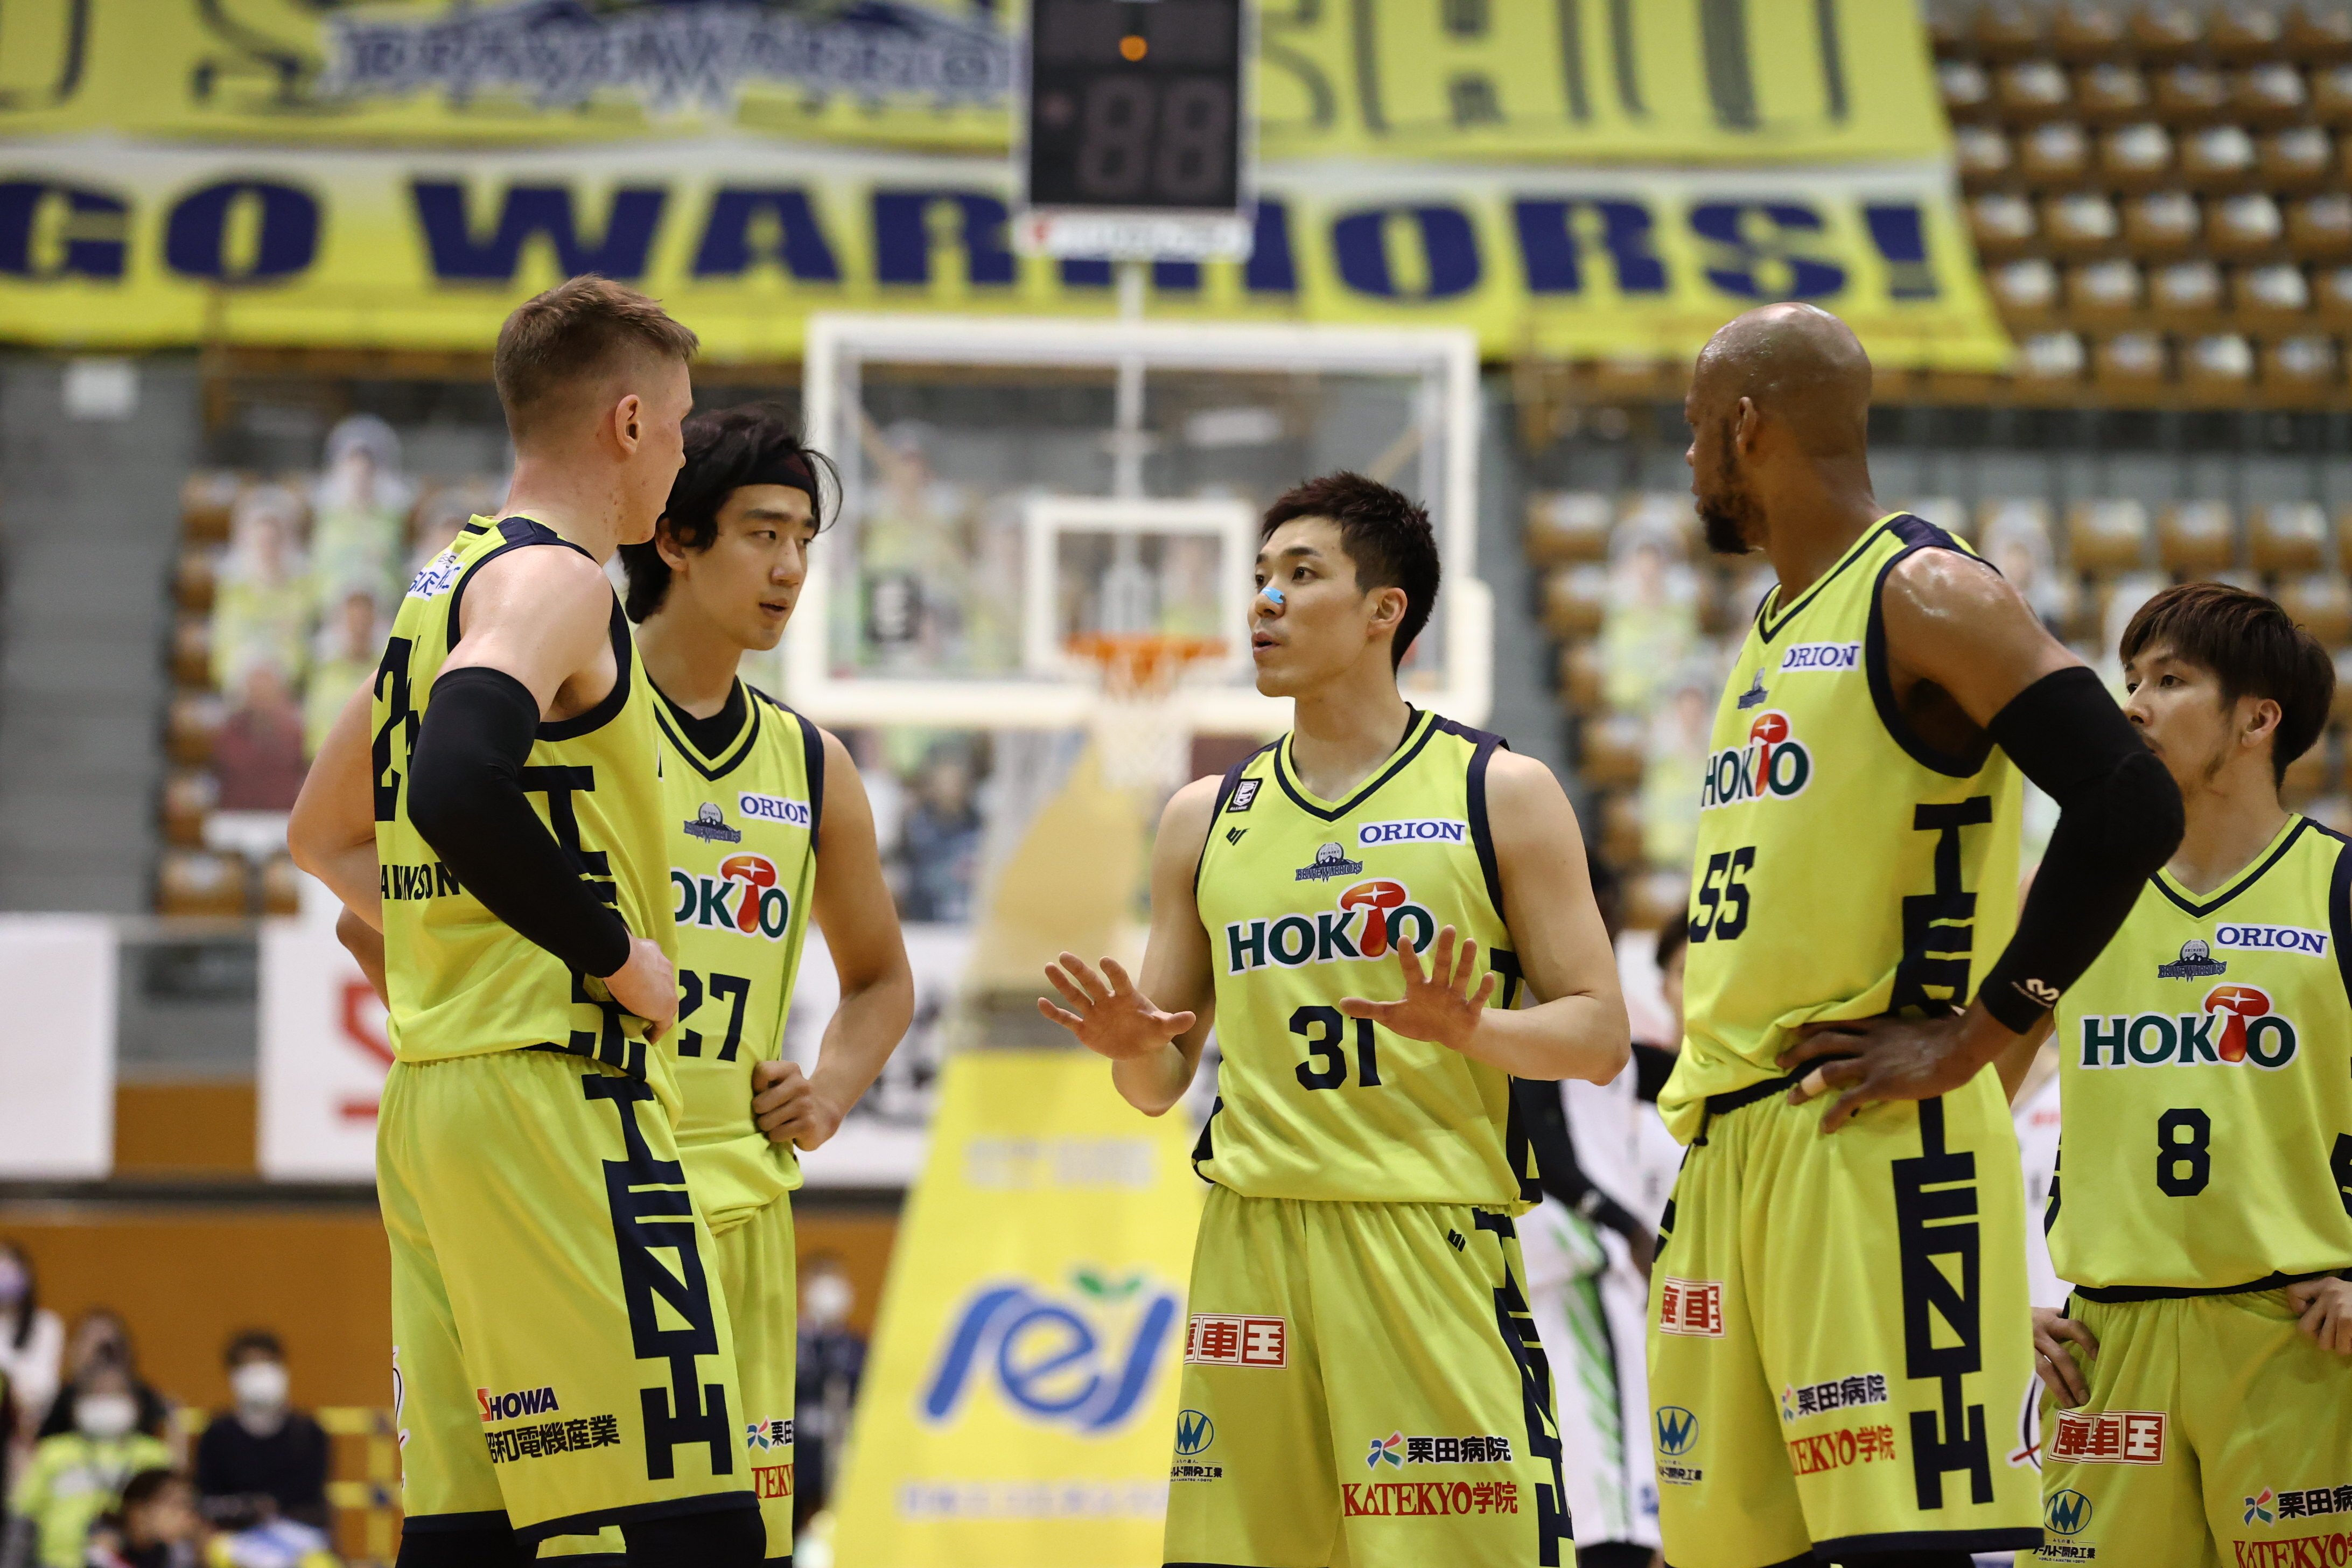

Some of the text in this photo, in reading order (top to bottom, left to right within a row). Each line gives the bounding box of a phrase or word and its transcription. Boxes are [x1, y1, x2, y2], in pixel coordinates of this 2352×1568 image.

[0, 180, 321, 281] GO
[411, 177, 1940, 302] WARIORS!
[1702, 713, 1809, 807] HOKTO
[740, 795, 809, 824] ORION
[1360, 822, 1465, 845] ORION
[1690, 845, 1755, 943] 55
[1227, 881, 1434, 972] HOKTO
[2216, 926, 2327, 953] ORION
[678, 969, 751, 1062] 27
[2082, 985, 2296, 1068] HOKTO
[1289, 1005, 1382, 1091] 31
[2157, 1108, 2211, 1197] 8
[477, 1387, 559, 1422] SHOWA
[1797, 1374, 1887, 1416] 栗田病院
[485, 1414, 620, 1464] 昭和電機産業
[1407, 1436, 1512, 1463] 栗田病院
[1341, 1481, 1518, 1516] KATEKYO学院
[2232, 1530, 2352, 1568] KATEKYO
